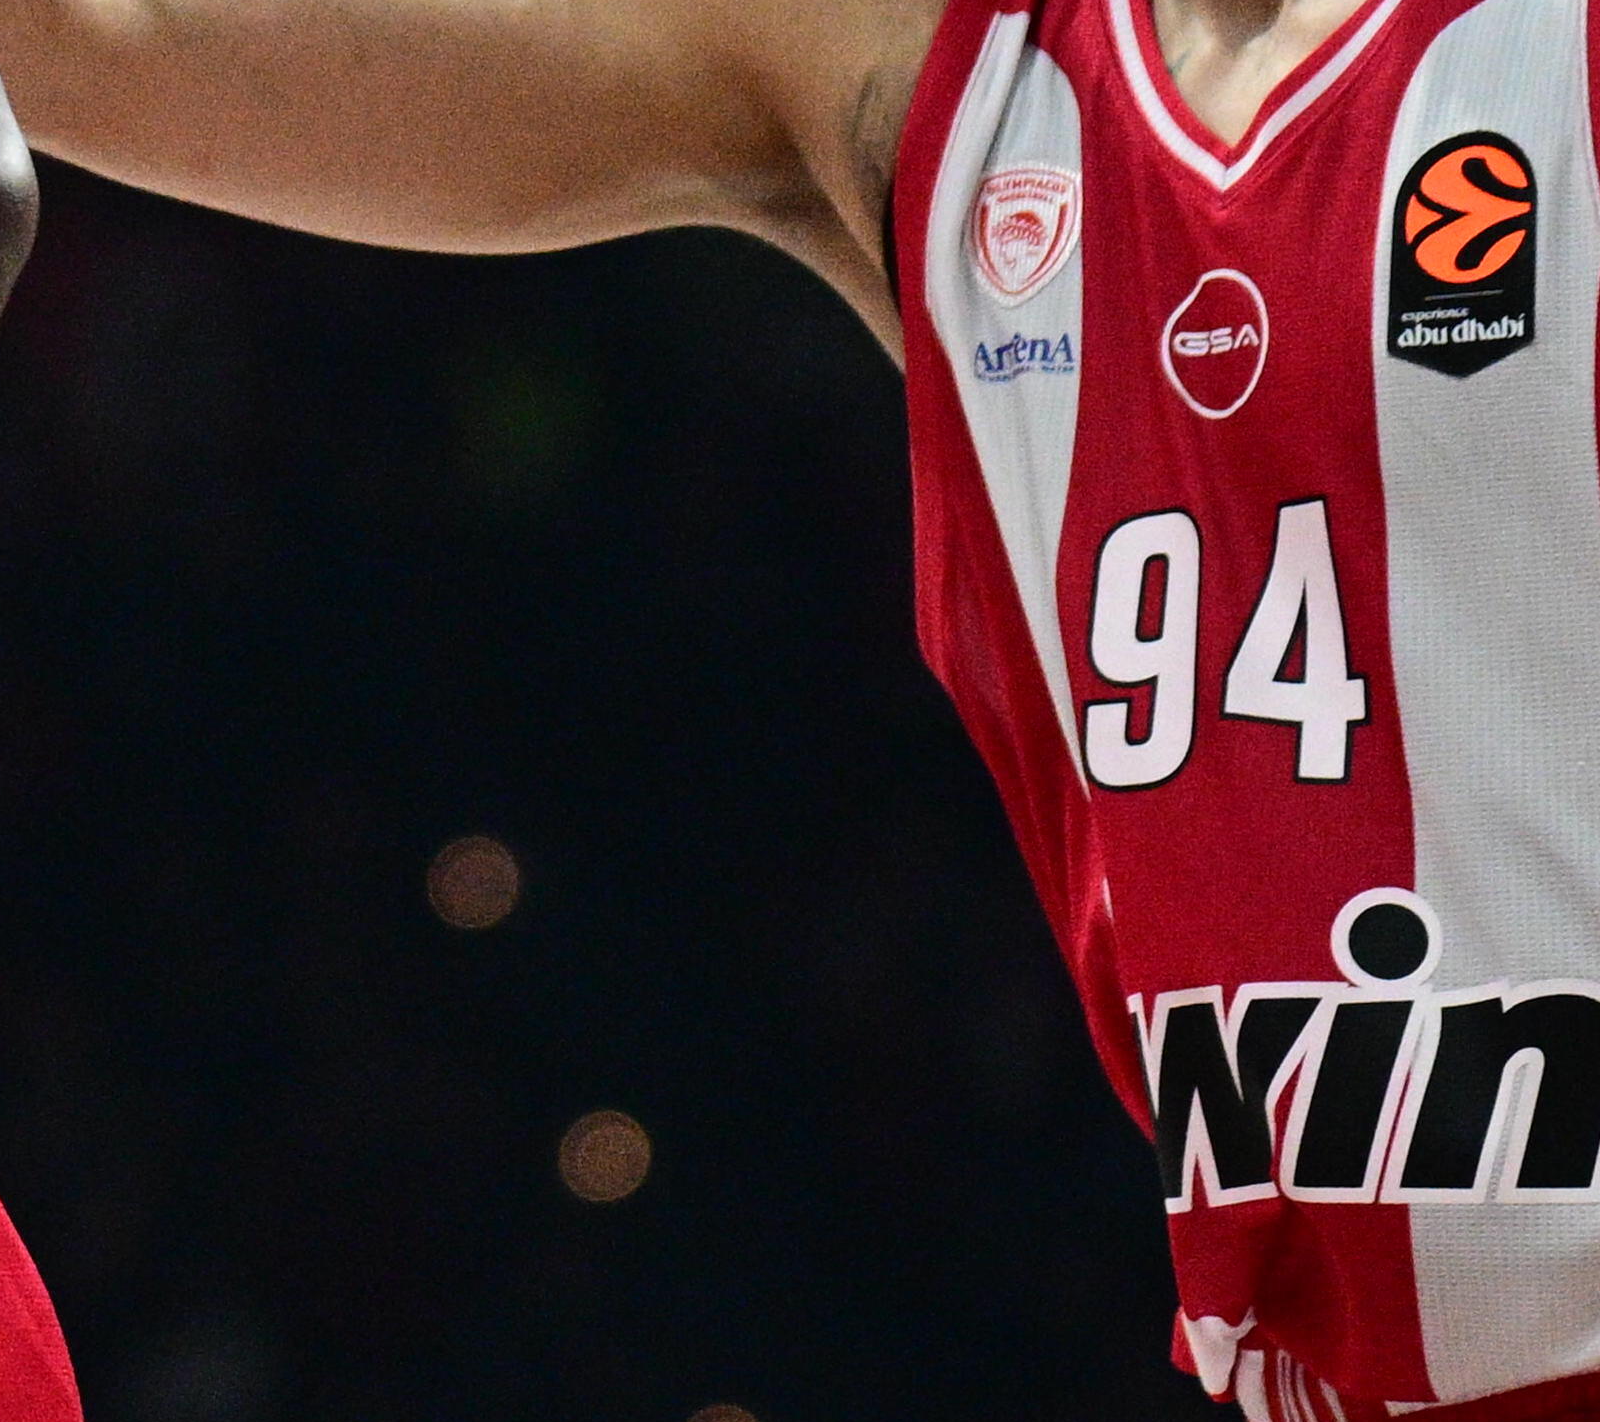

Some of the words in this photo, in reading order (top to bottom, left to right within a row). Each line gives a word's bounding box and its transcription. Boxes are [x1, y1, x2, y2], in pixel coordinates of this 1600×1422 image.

[1174, 324, 1260, 357] GSA
[1397, 322, 1449, 347] abu
[1451, 313, 1526, 343] dhabi
[1084, 495, 1367, 788] 94
